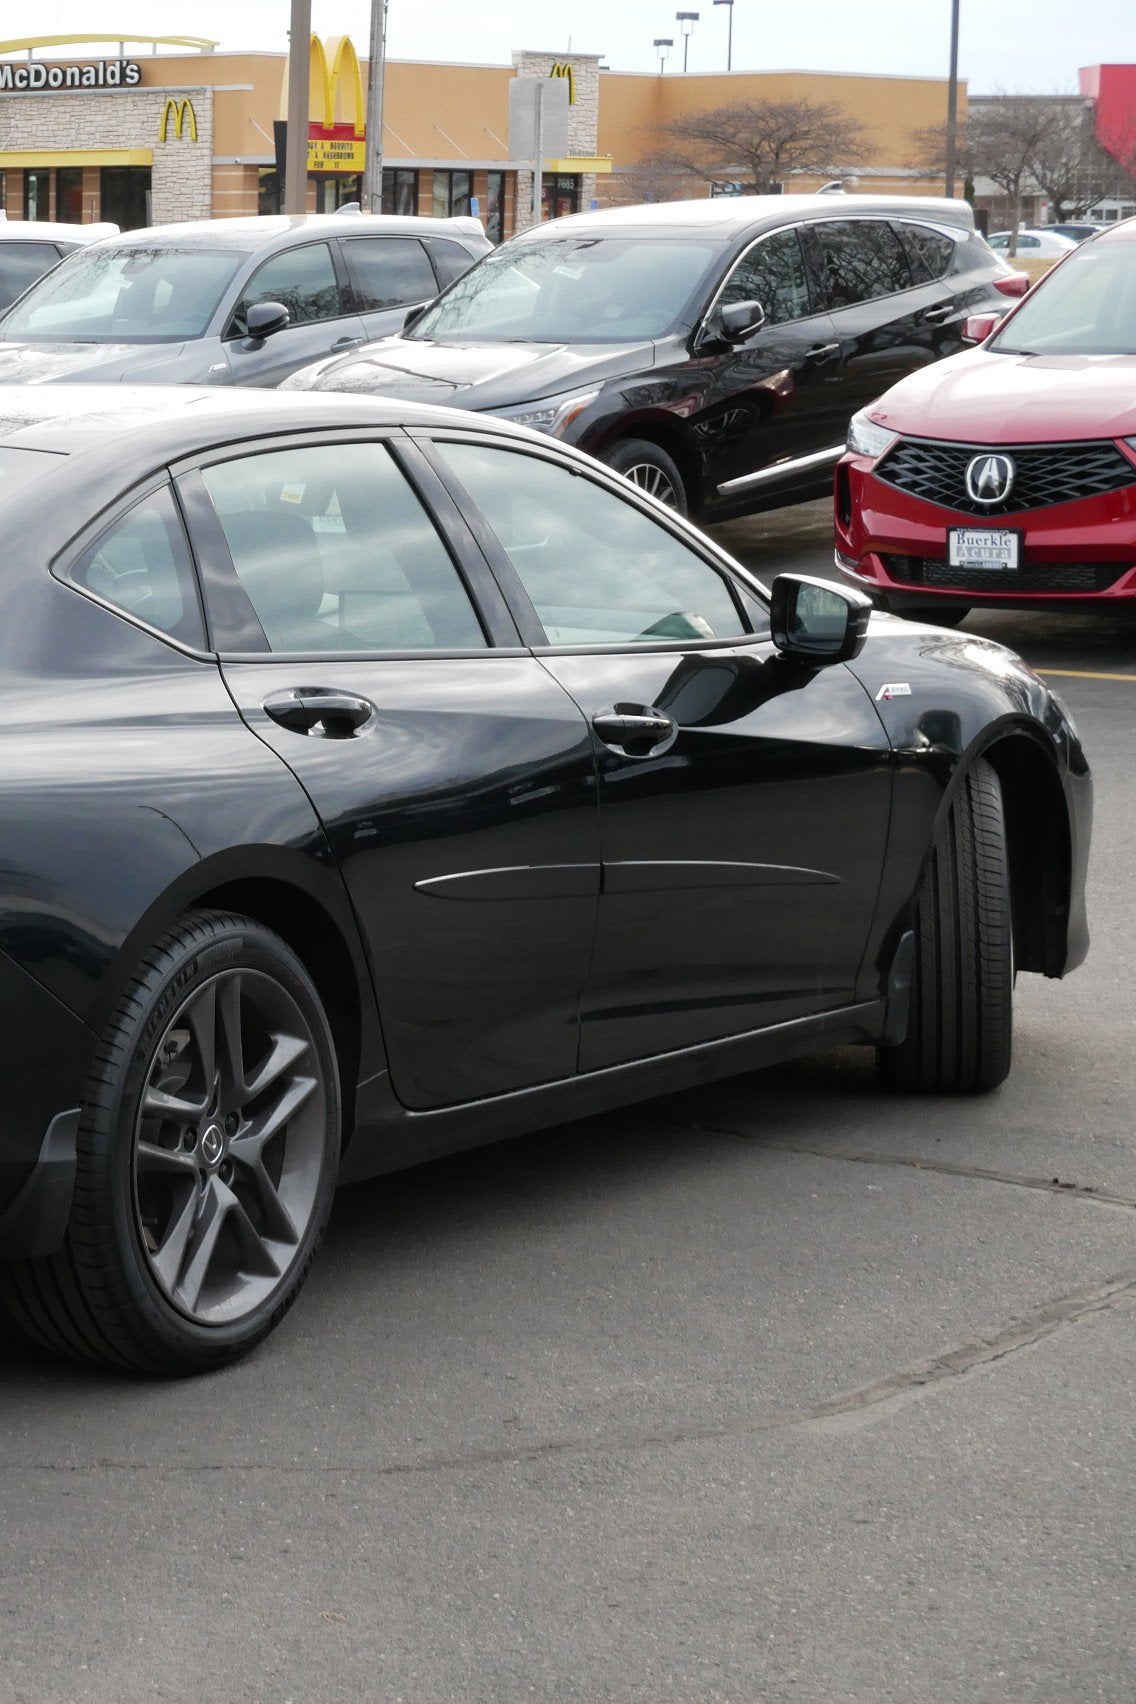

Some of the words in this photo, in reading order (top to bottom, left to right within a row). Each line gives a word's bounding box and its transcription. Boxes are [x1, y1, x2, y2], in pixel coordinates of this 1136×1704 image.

[330, 142, 353, 150] BURRITO
[323, 151, 354, 160] HASHBROWN
[957, 532, 1011, 547] Buerkle
[959, 546, 1009, 558] Acura
